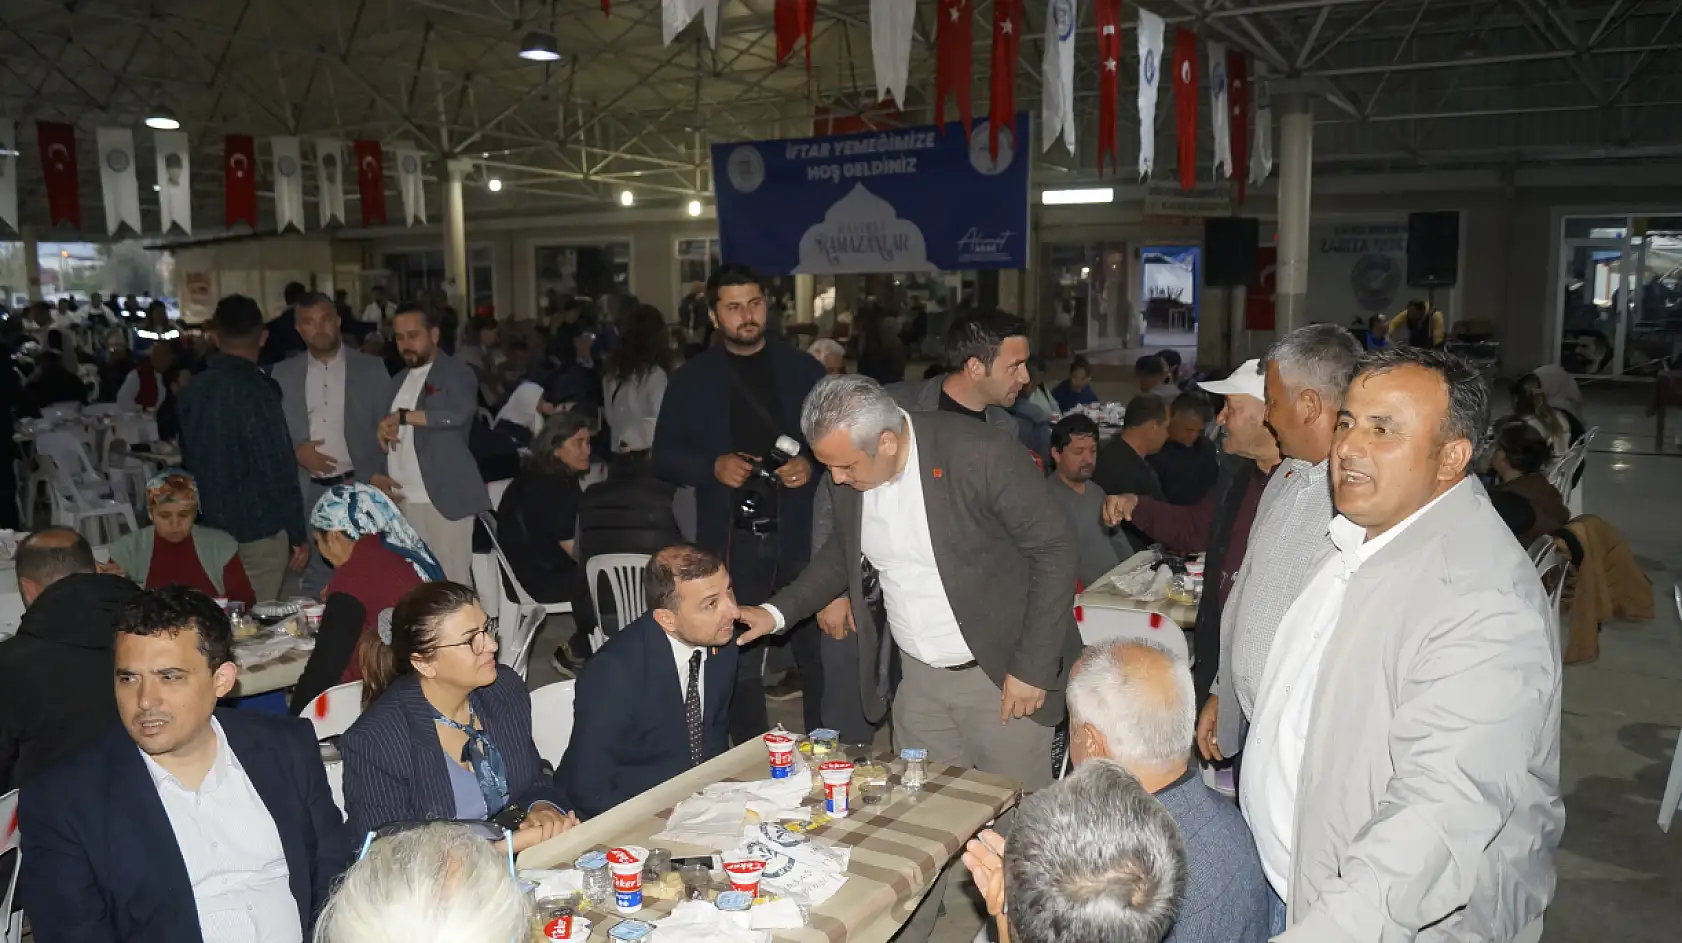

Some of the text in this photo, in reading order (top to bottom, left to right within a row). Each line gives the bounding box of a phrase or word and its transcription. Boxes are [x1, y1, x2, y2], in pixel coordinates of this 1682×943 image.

[785, 131, 936, 160] İFTAR YEMEĞİMİZE
[807, 153, 917, 184] HOŞ GELDİNİZ
